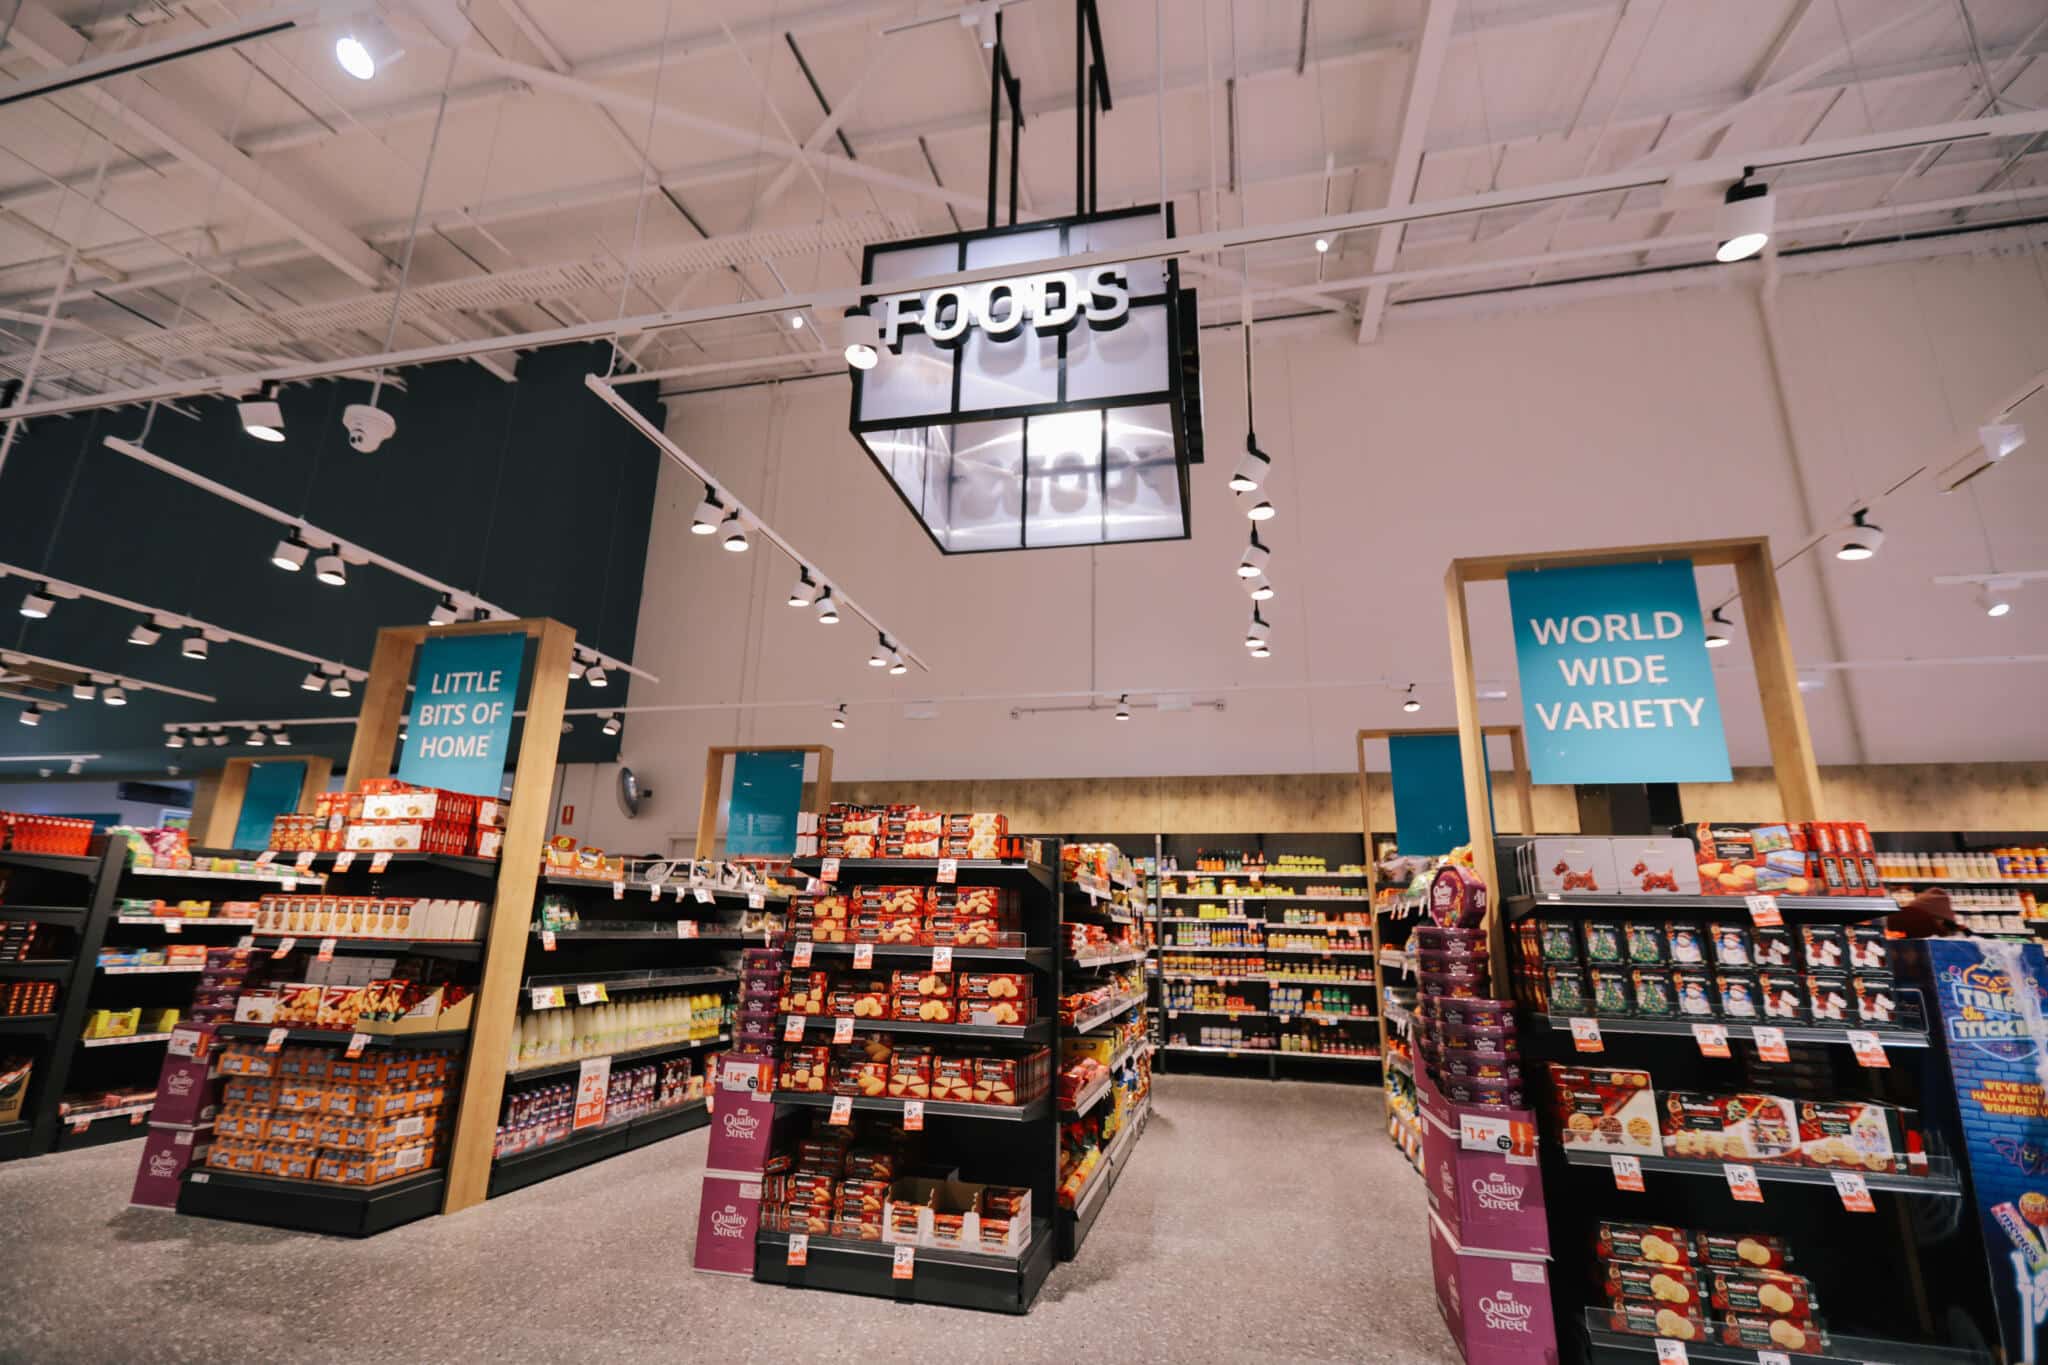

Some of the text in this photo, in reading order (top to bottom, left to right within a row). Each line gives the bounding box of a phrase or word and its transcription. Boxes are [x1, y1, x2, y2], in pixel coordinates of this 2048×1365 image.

[885, 265, 1130, 346] FOODS
[1529, 611, 1684, 646] WORLD
[1558, 654, 1669, 687] WIDE
[431, 670, 502, 695] LITTLE
[418, 701, 504, 727] BITS OF
[1535, 697, 1705, 731] VARIETY
[419, 734, 491, 759] HOME
[1971, 1090, 2039, 1105] HALLOWEEN
[1983, 1103, 2037, 1116] WRAPPED
[723, 1113, 760, 1129] Quality
[725, 1125, 755, 1140] Street
[1472, 1178, 1524, 1198] Quality
[1478, 1194, 1522, 1212] Street
[711, 1210, 748, 1227] Quality
[713, 1224, 744, 1239] Street
[2000, 1213, 2039, 1263] mentos
[1479, 1296, 1532, 1319] Quality
[1485, 1312, 1532, 1333] Street
